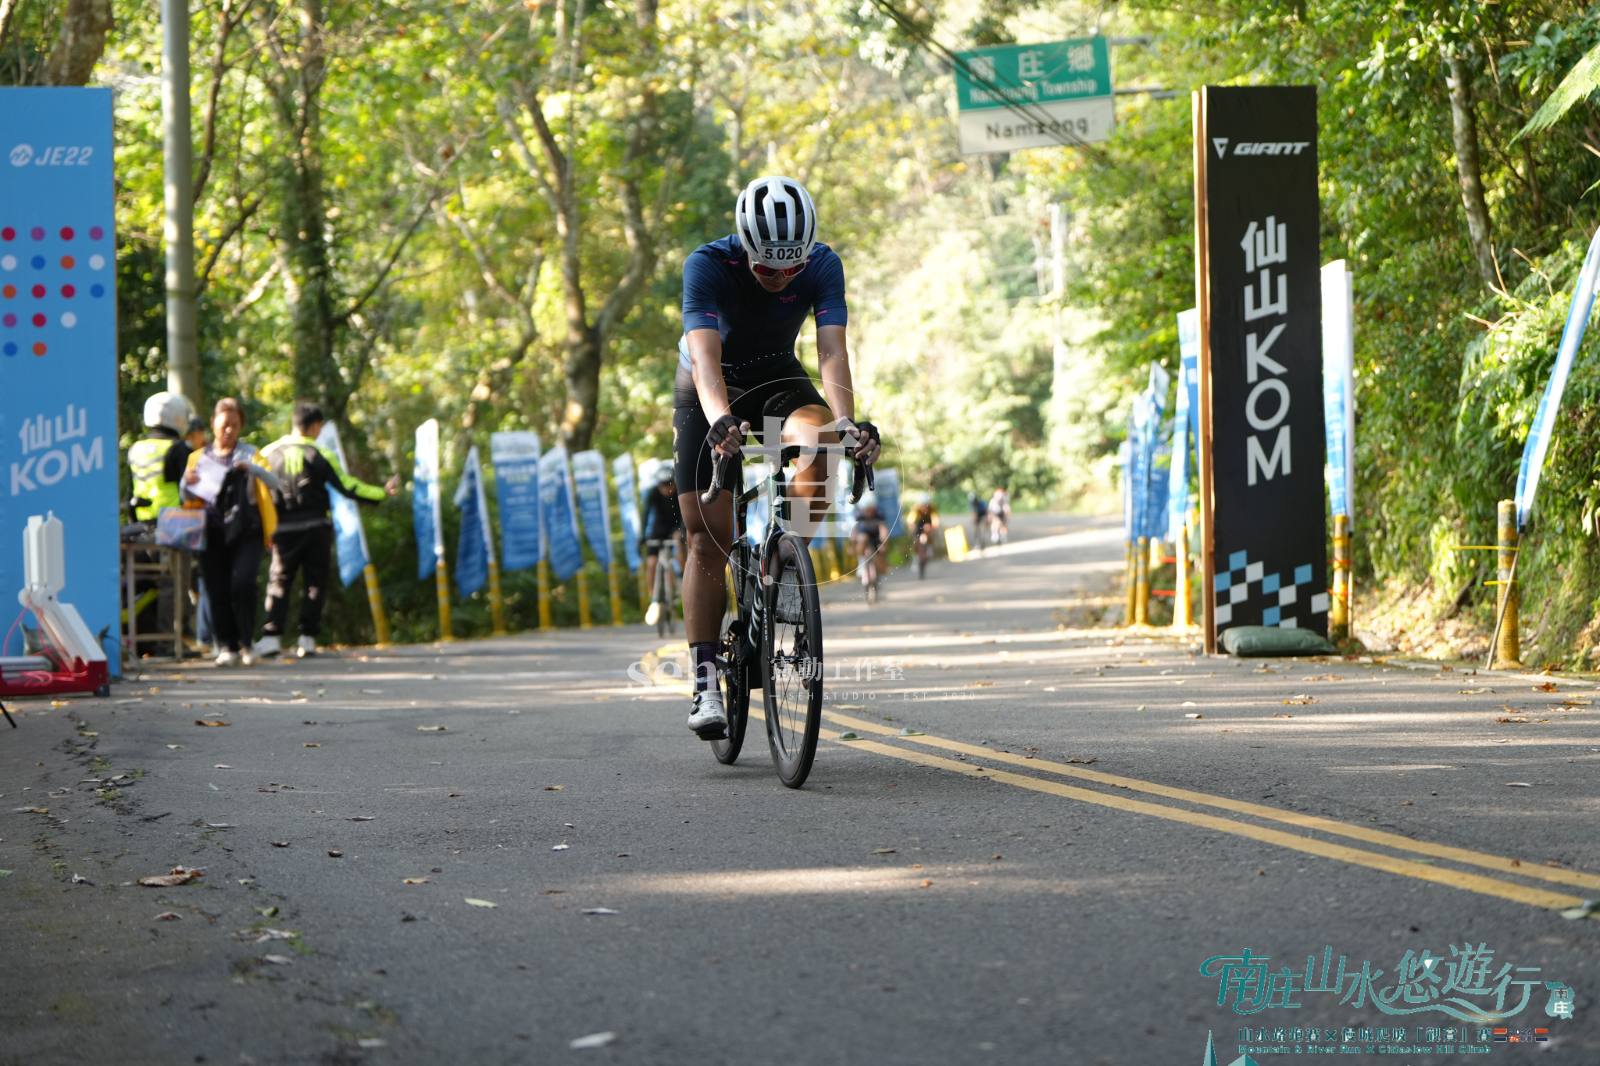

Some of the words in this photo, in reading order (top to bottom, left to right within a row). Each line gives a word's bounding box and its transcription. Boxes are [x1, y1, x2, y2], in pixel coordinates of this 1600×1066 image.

[969, 85, 1039, 104] Nanuang
[34, 146, 94, 167] JE22
[1233, 140, 1311, 157] GIANT
[18, 403, 88, 455] 仙山
[10, 436, 105, 496] KOM
